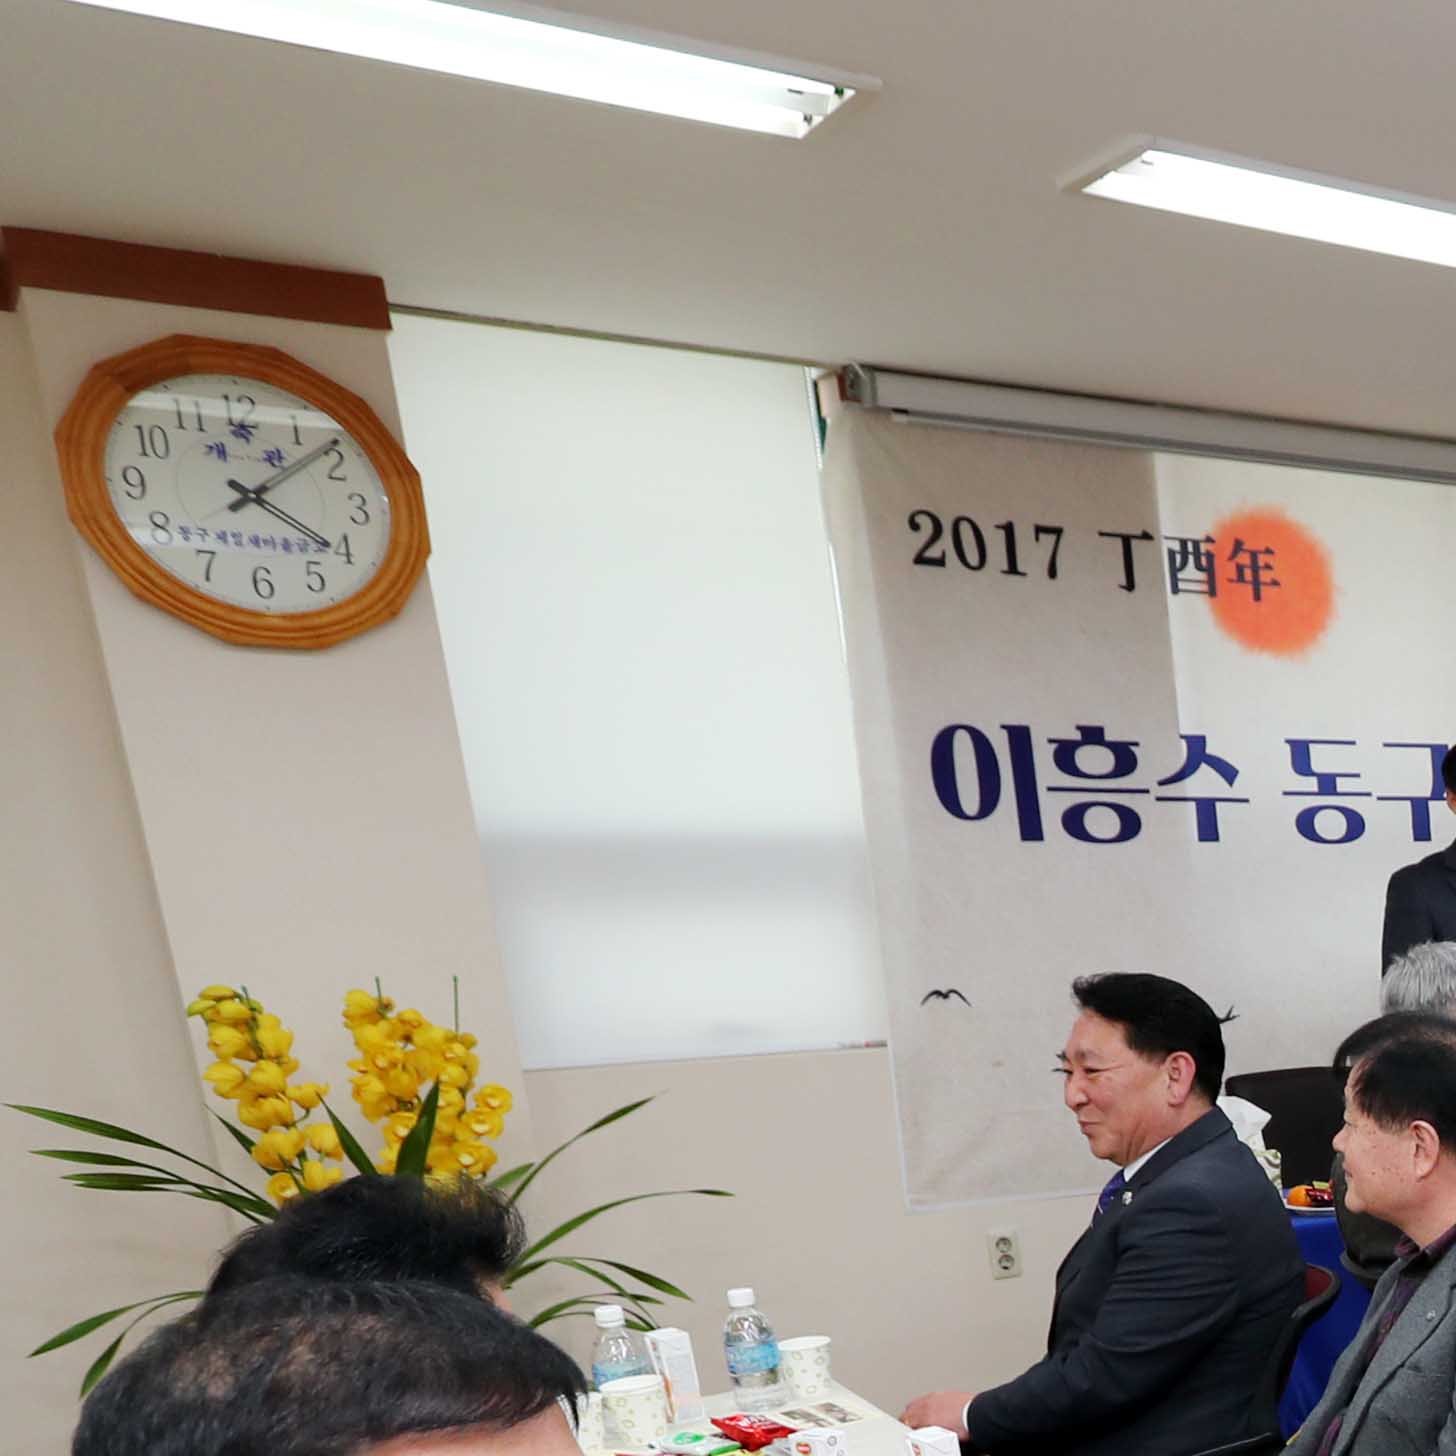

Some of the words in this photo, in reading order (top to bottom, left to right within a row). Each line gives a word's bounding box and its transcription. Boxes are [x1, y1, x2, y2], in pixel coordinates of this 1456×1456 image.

[907, 509, 1065, 581] 2017
[1099, 528, 1281, 602] 丁酉年
[930, 723, 1251, 844] 이흥수
